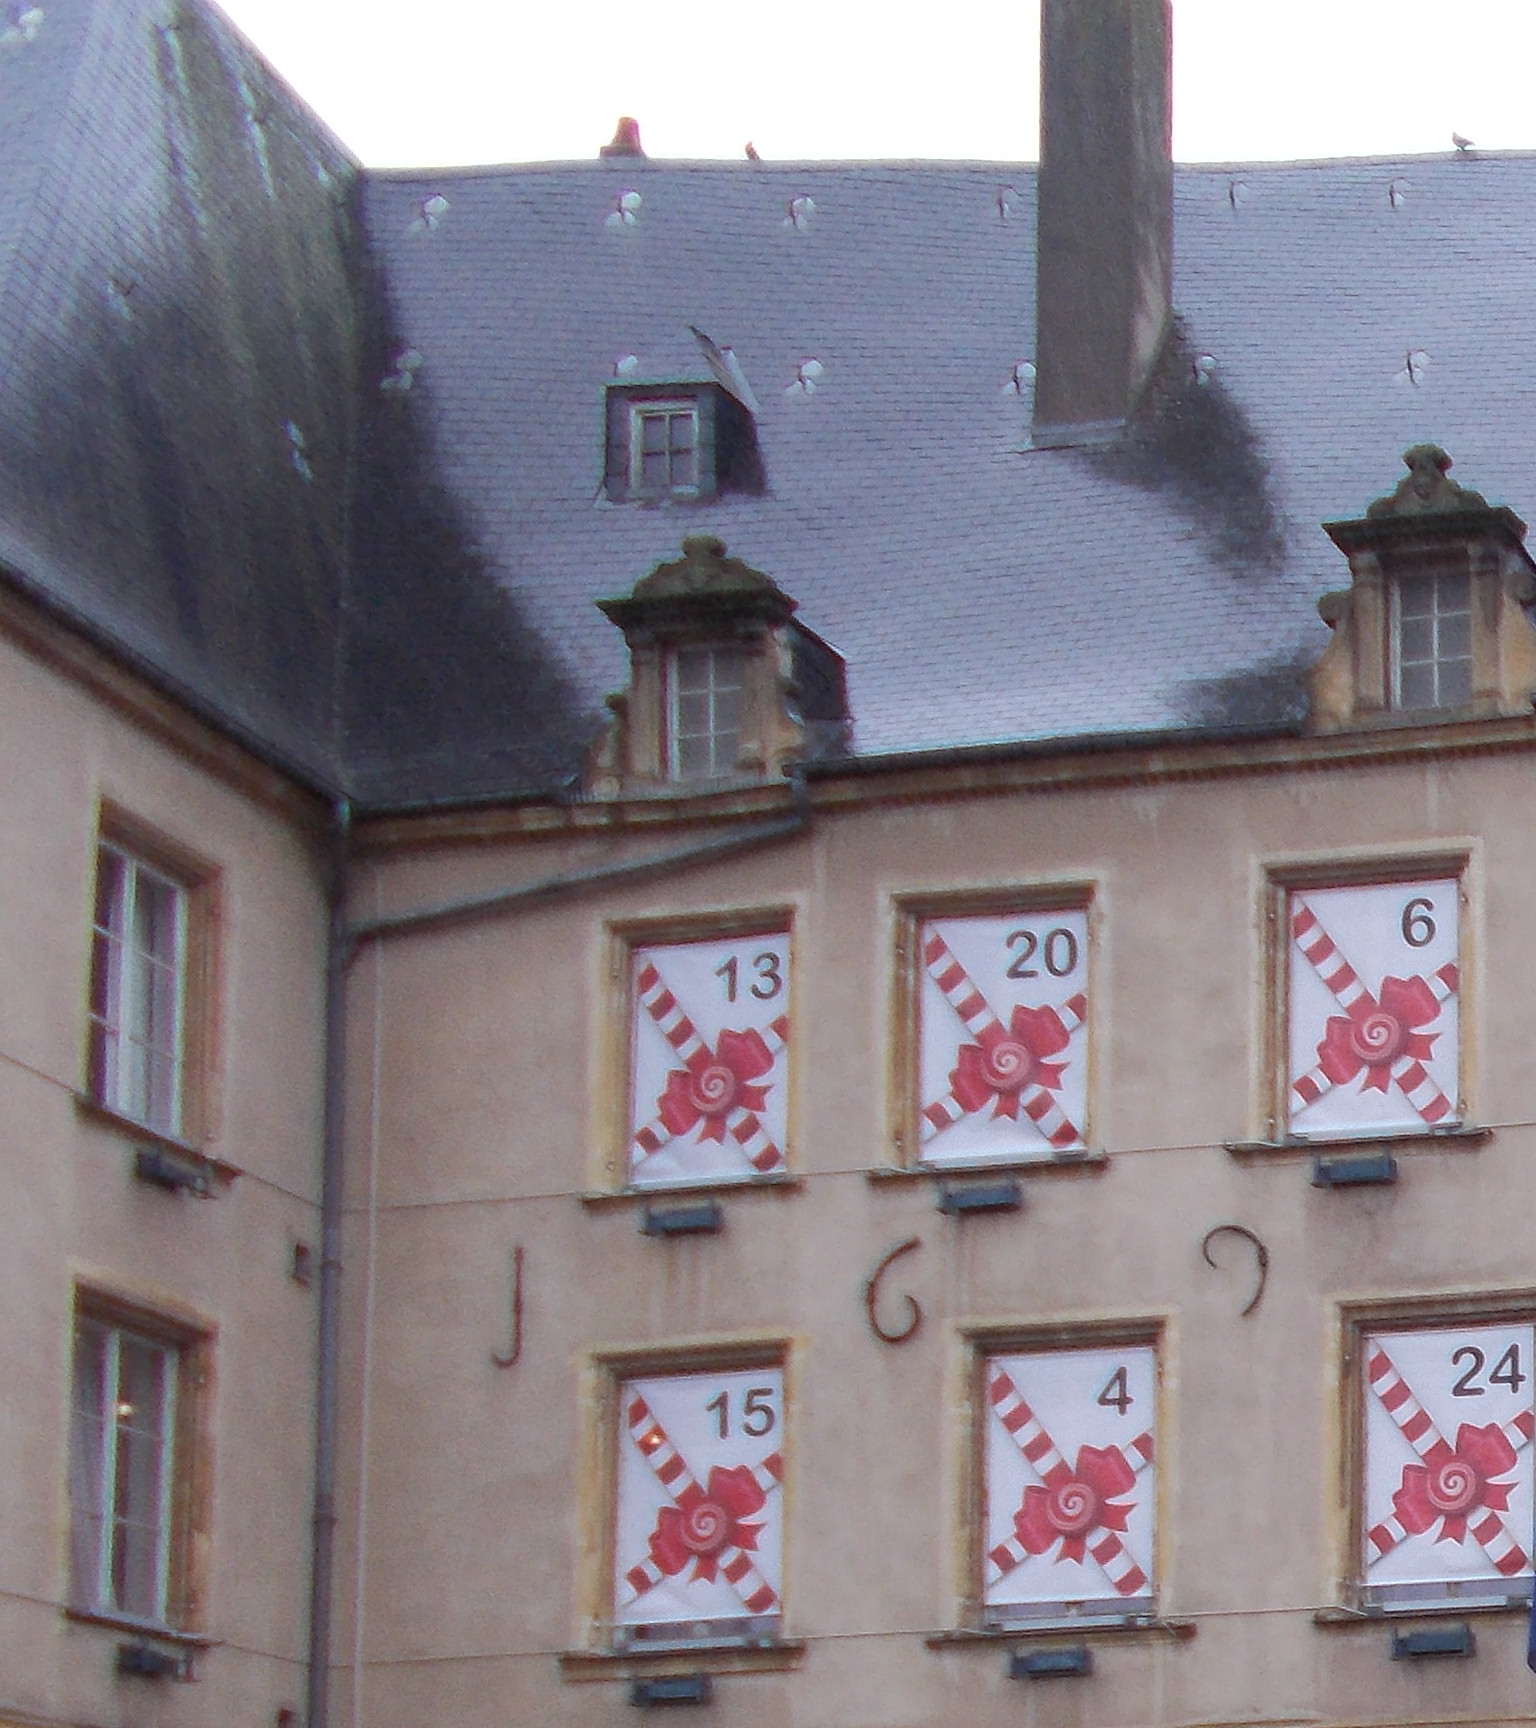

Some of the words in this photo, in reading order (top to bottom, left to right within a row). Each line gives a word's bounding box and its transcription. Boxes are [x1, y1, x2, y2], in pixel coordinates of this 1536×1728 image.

[1402, 899, 1435, 947] 6
[716, 952, 782, 1002] 13
[1007, 929, 1077, 979] 20
[1098, 1367, 1133, 1415] 4
[1452, 1344, 1525, 1396] 24
[707, 1388, 774, 1439] 15
